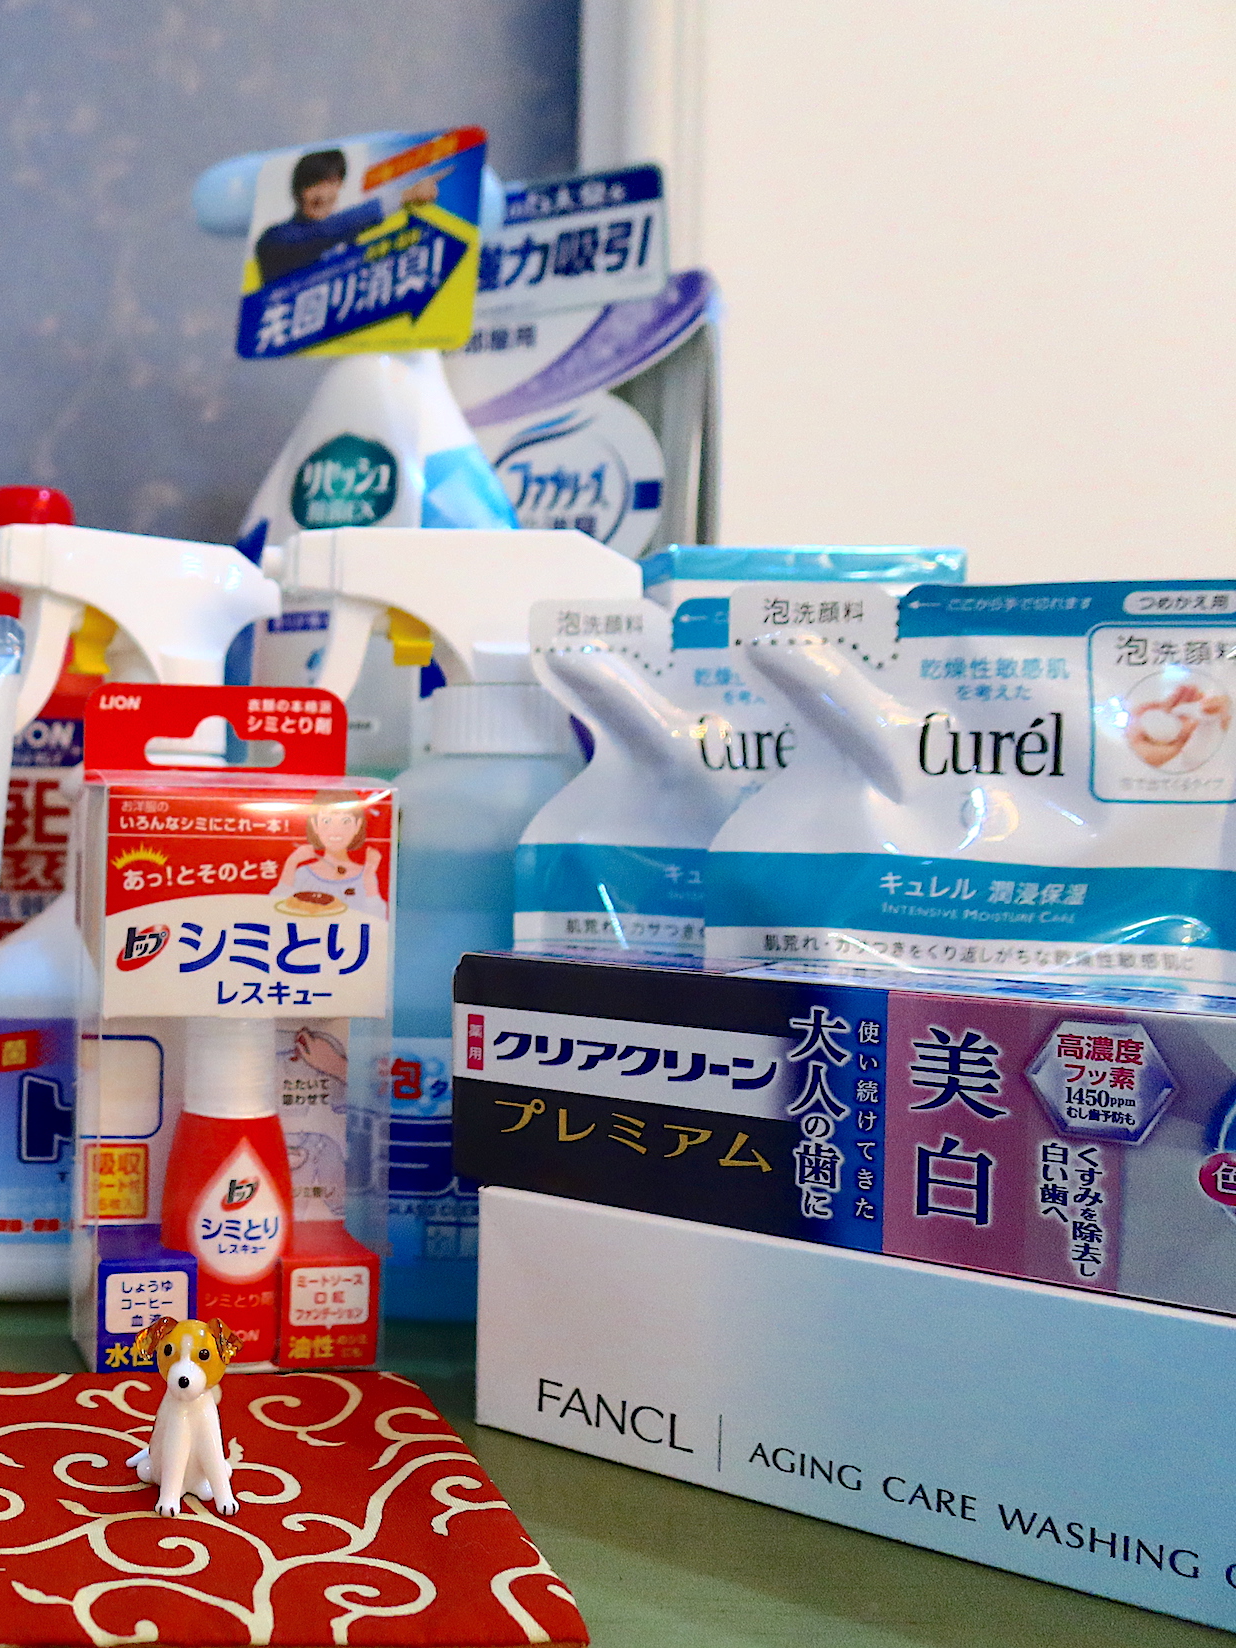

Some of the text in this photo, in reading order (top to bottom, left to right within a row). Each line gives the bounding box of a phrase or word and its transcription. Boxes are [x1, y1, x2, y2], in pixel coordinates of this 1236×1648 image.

[763, 598, 865, 625] 泡洗顔料
[920, 657, 1070, 681] 乾燥性敏感肌
[99, 695, 142, 711] LION
[957, 684, 1033, 701] を考えた
[919, 712, 1066, 777] Curél
[119, 815, 291, 834] いろんなシミにこれ一本!
[122, 859, 280, 892] あっ!とそのとき
[879, 871, 978, 900] キュレル
[123, 922, 371, 975] トップ シミとり
[217, 980, 332, 1005] レスキュー
[493, 1030, 777, 1090] クリアクリーン
[1056, 1032, 1145, 1066] 高濃度
[1064, 1062, 1135, 1091] フッ素
[786, 1005, 852, 1218] 大人の歯に
[1064, 1086, 1136, 1109] 1450ppm
[855, 1020, 881, 1220] 使い続けてきた
[909, 1026, 1011, 1227] 美白
[1066, 1106, 1136, 1126] むし歯予防も
[494, 1097, 773, 1173] プレミアム
[1040, 1142, 1070, 1223] 白い歯へ
[1071, 1146, 1104, 1277] くすみを除去し
[201, 1216, 279, 1241] シミとり
[218, 1243, 266, 1254] レスキュー
[121, 1280, 173, 1294] しょうゆ
[121, 1298, 173, 1310] コーヒー
[537, 1378, 694, 1455] FANCL
[748, 1441, 863, 1492] AGING
[882, 1475, 978, 1523] CARE
[997, 1503, 1201, 1581] WASHING
